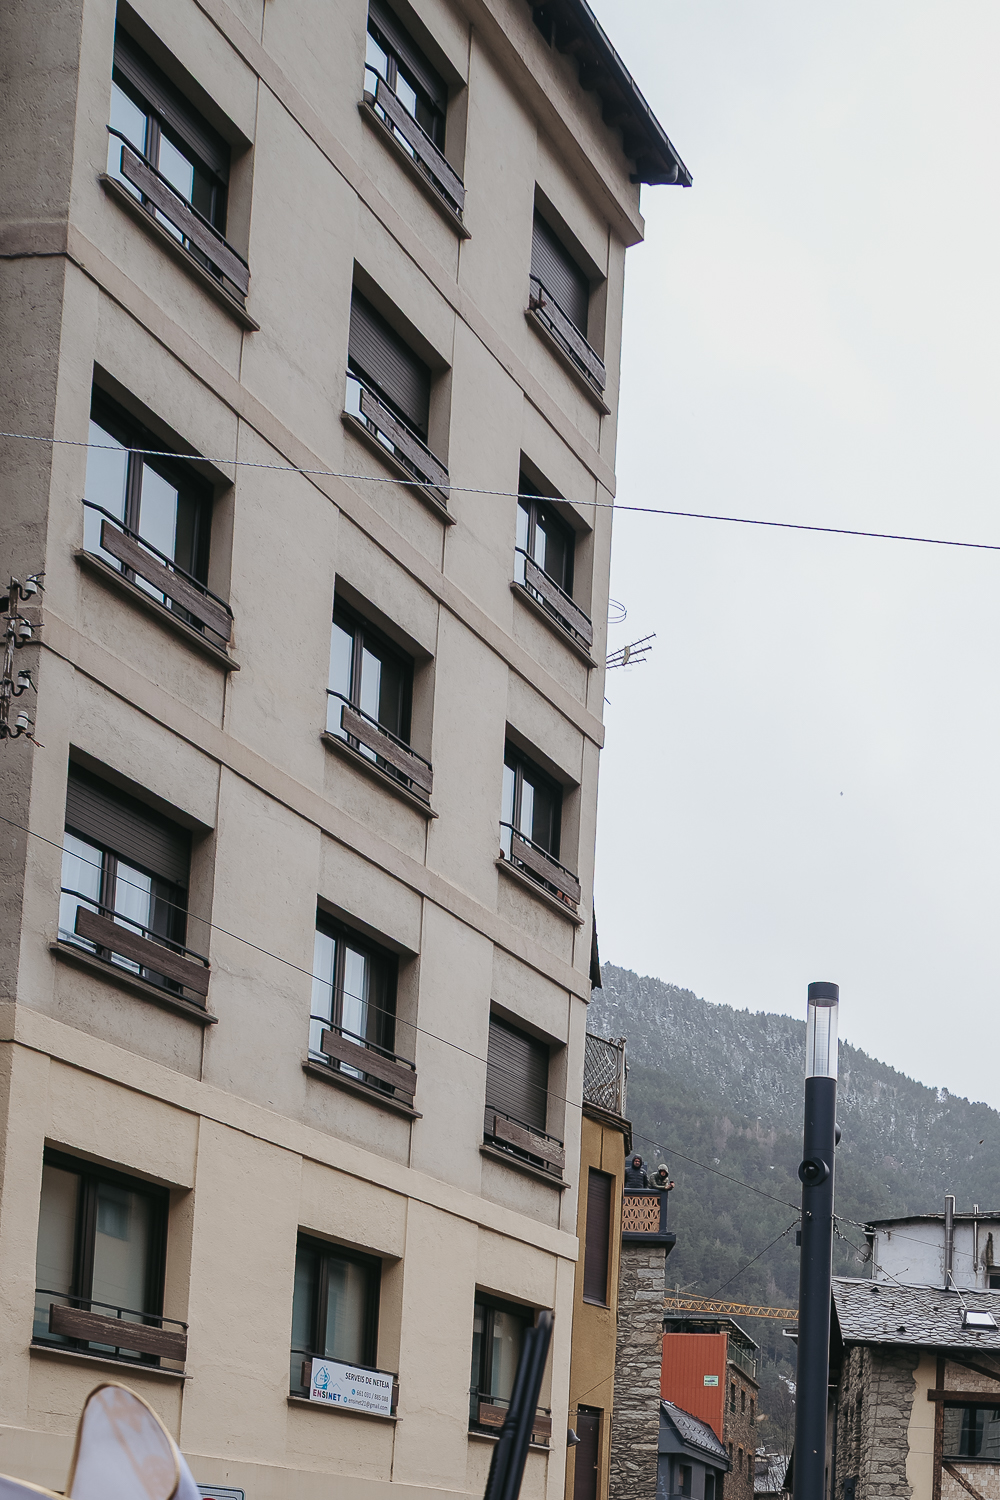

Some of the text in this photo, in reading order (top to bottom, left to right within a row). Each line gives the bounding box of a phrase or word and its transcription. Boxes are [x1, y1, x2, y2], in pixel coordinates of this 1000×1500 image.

[345, 1372, 390, 1389] SERVEIS DE NETEJA
[312, 1389, 342, 1402] ENSINET
